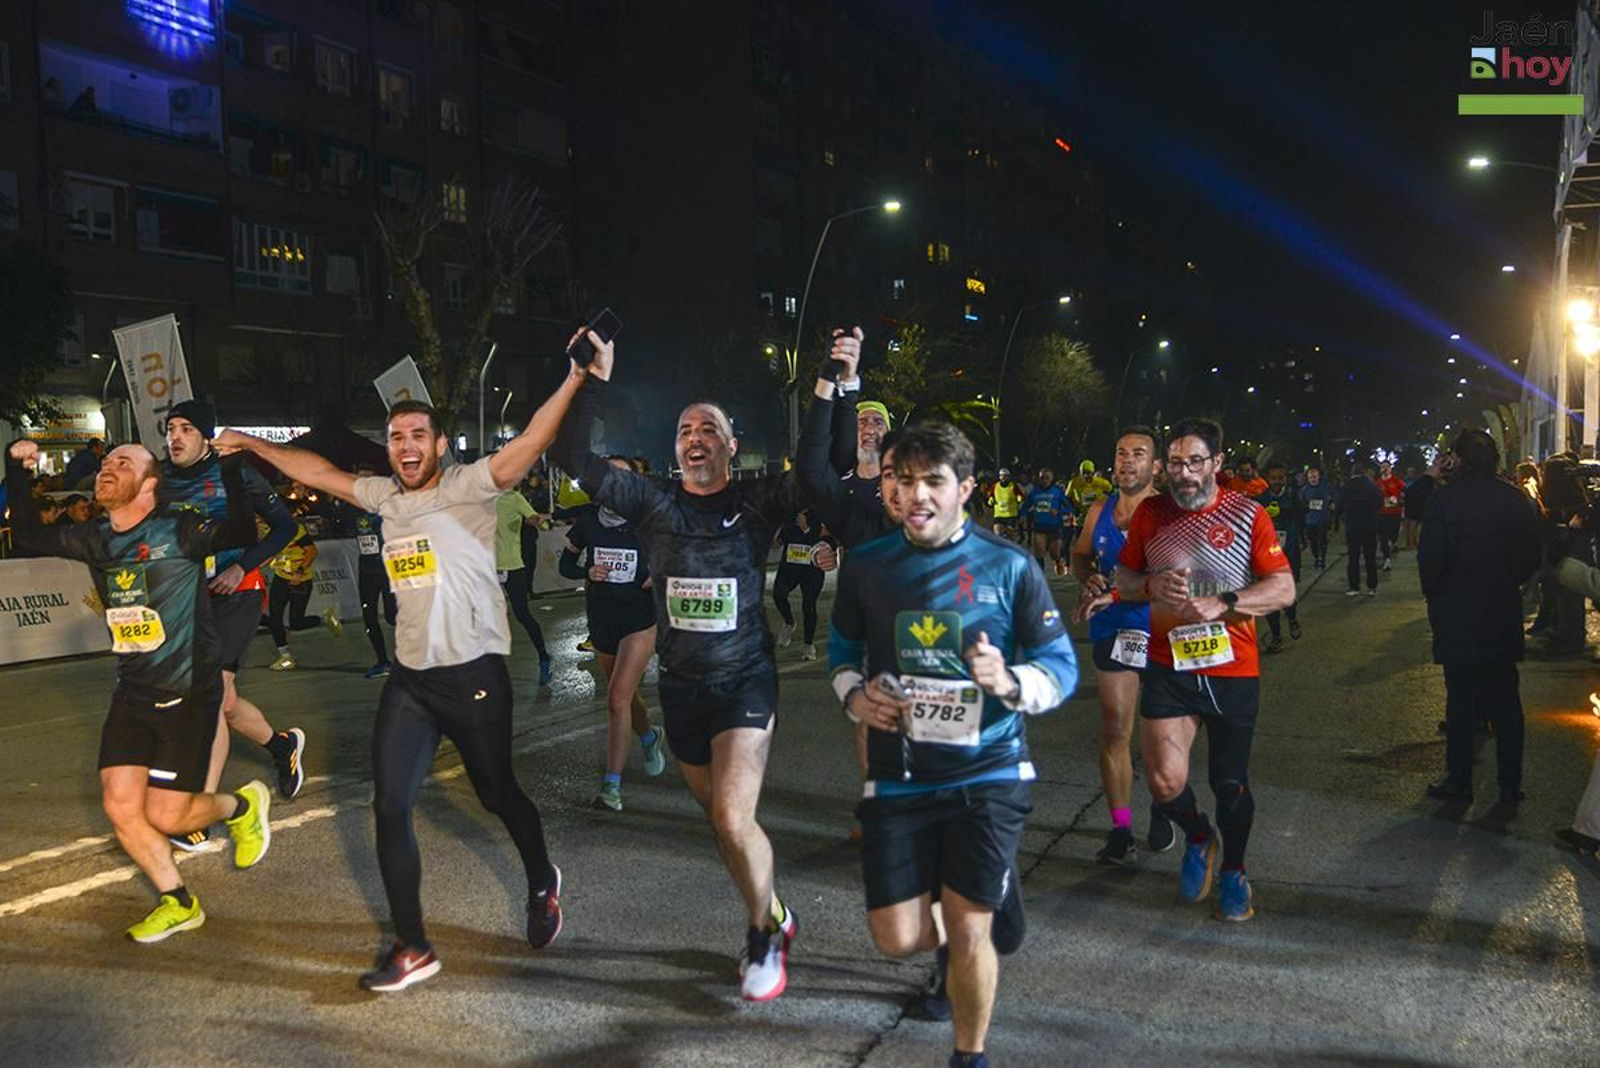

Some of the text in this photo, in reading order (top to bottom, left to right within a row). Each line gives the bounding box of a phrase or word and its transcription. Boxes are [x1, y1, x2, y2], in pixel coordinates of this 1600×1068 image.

[0, 593, 69, 612] AJA RURAL
[680, 599, 724, 613] 6799
[16, 608, 51, 627] JAÉN
[1183, 638, 1219, 654] 5718
[913, 703, 966, 721] 5782
